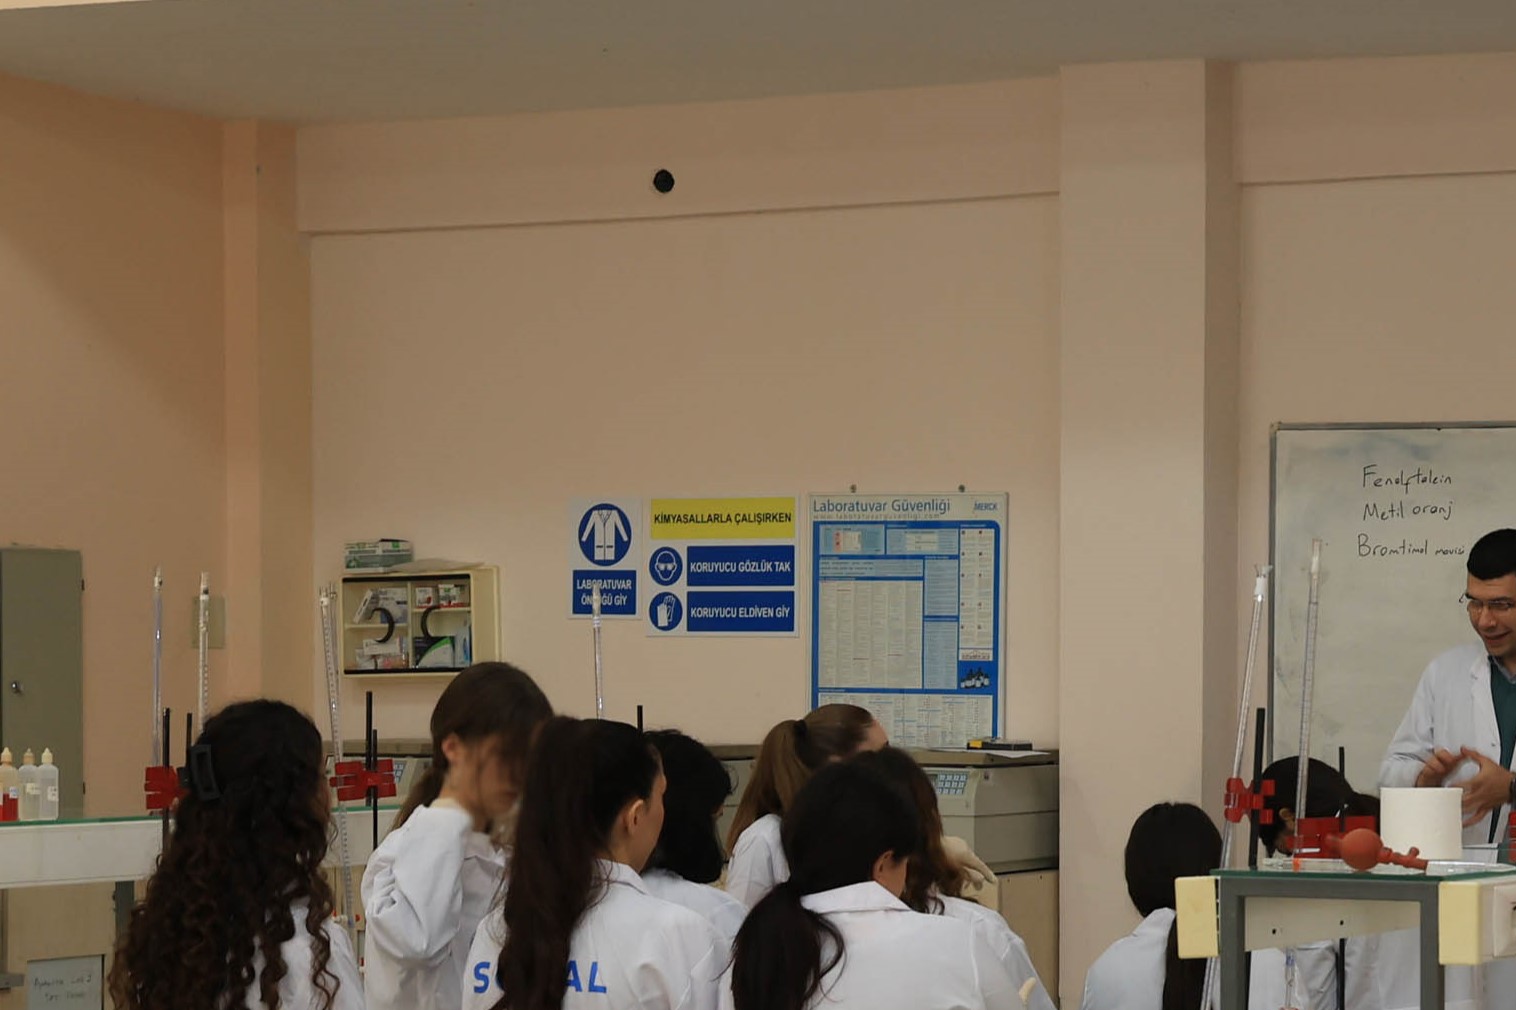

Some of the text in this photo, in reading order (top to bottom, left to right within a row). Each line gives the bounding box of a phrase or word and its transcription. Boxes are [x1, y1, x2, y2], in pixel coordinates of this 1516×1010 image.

[813, 498, 950, 514] Laboratuvar Güvenliği
[974, 502, 998, 511] MERCK
[1363, 500, 1453, 521] Metil oranj
[654, 512, 792, 526] KİMYASALLARLA ÇALIŞIRKEN
[690, 560, 791, 573] KORUYUCU GÖZLÜK TAK
[581, 592, 628, 606] ÖNĞÜ GİY
[690, 605, 790, 618] KORUYUCU ELDİVEN GİY
[473, 960, 607, 994] SAL
